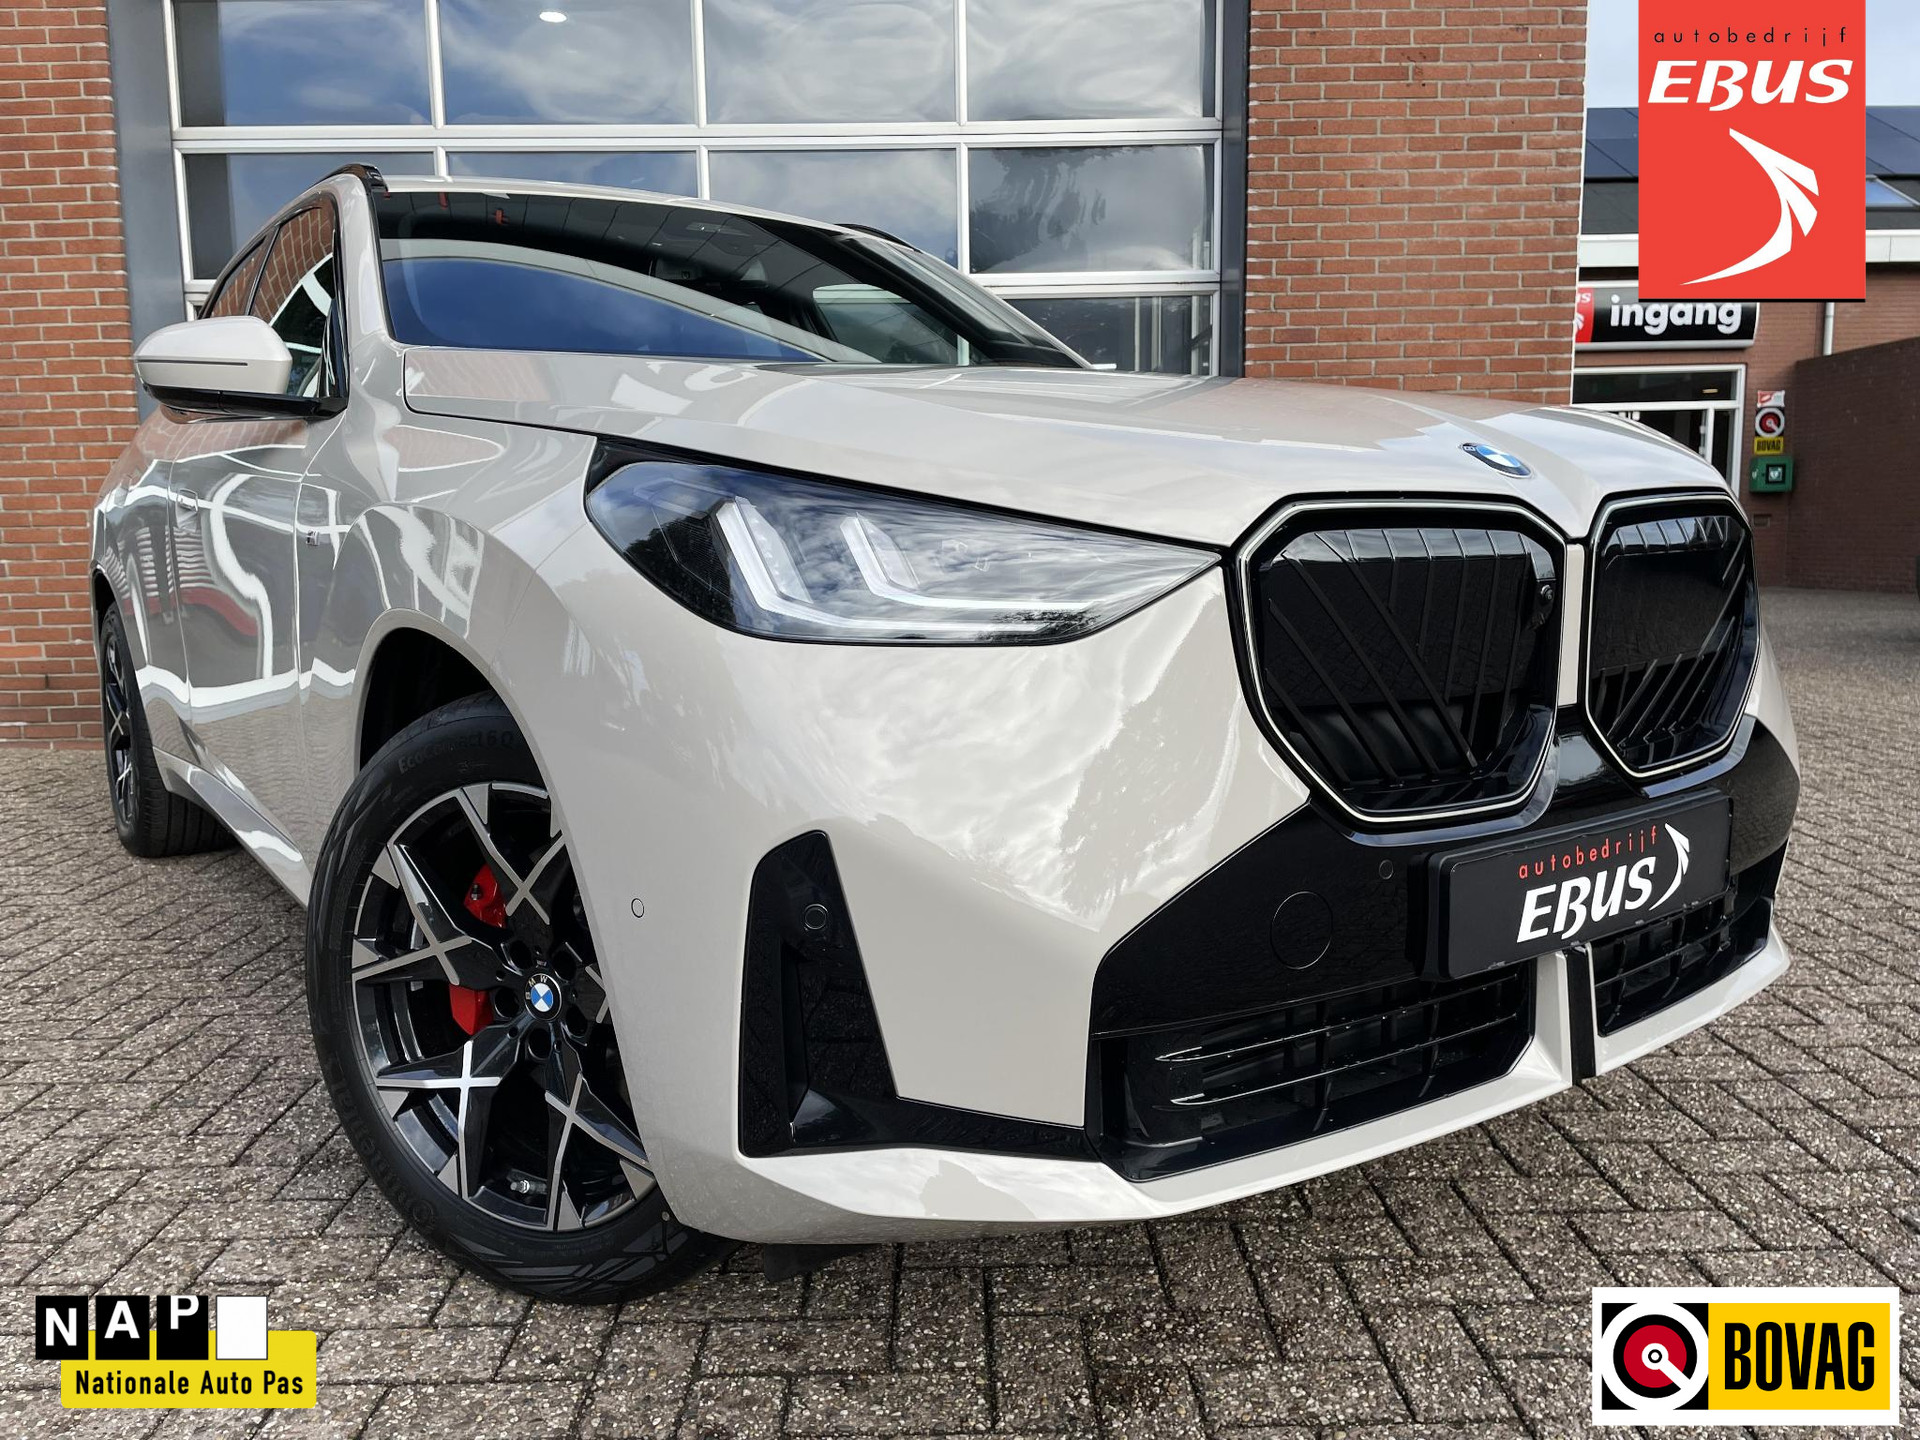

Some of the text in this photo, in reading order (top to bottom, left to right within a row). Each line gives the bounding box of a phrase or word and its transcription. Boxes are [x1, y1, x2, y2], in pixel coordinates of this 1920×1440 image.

[1610, 294, 1742, 335] ingang
[1756, 440, 1781, 451] BOVAG
[1518, 825, 1657, 879] autobedrijf
[1516, 856, 1656, 943] EBUS
